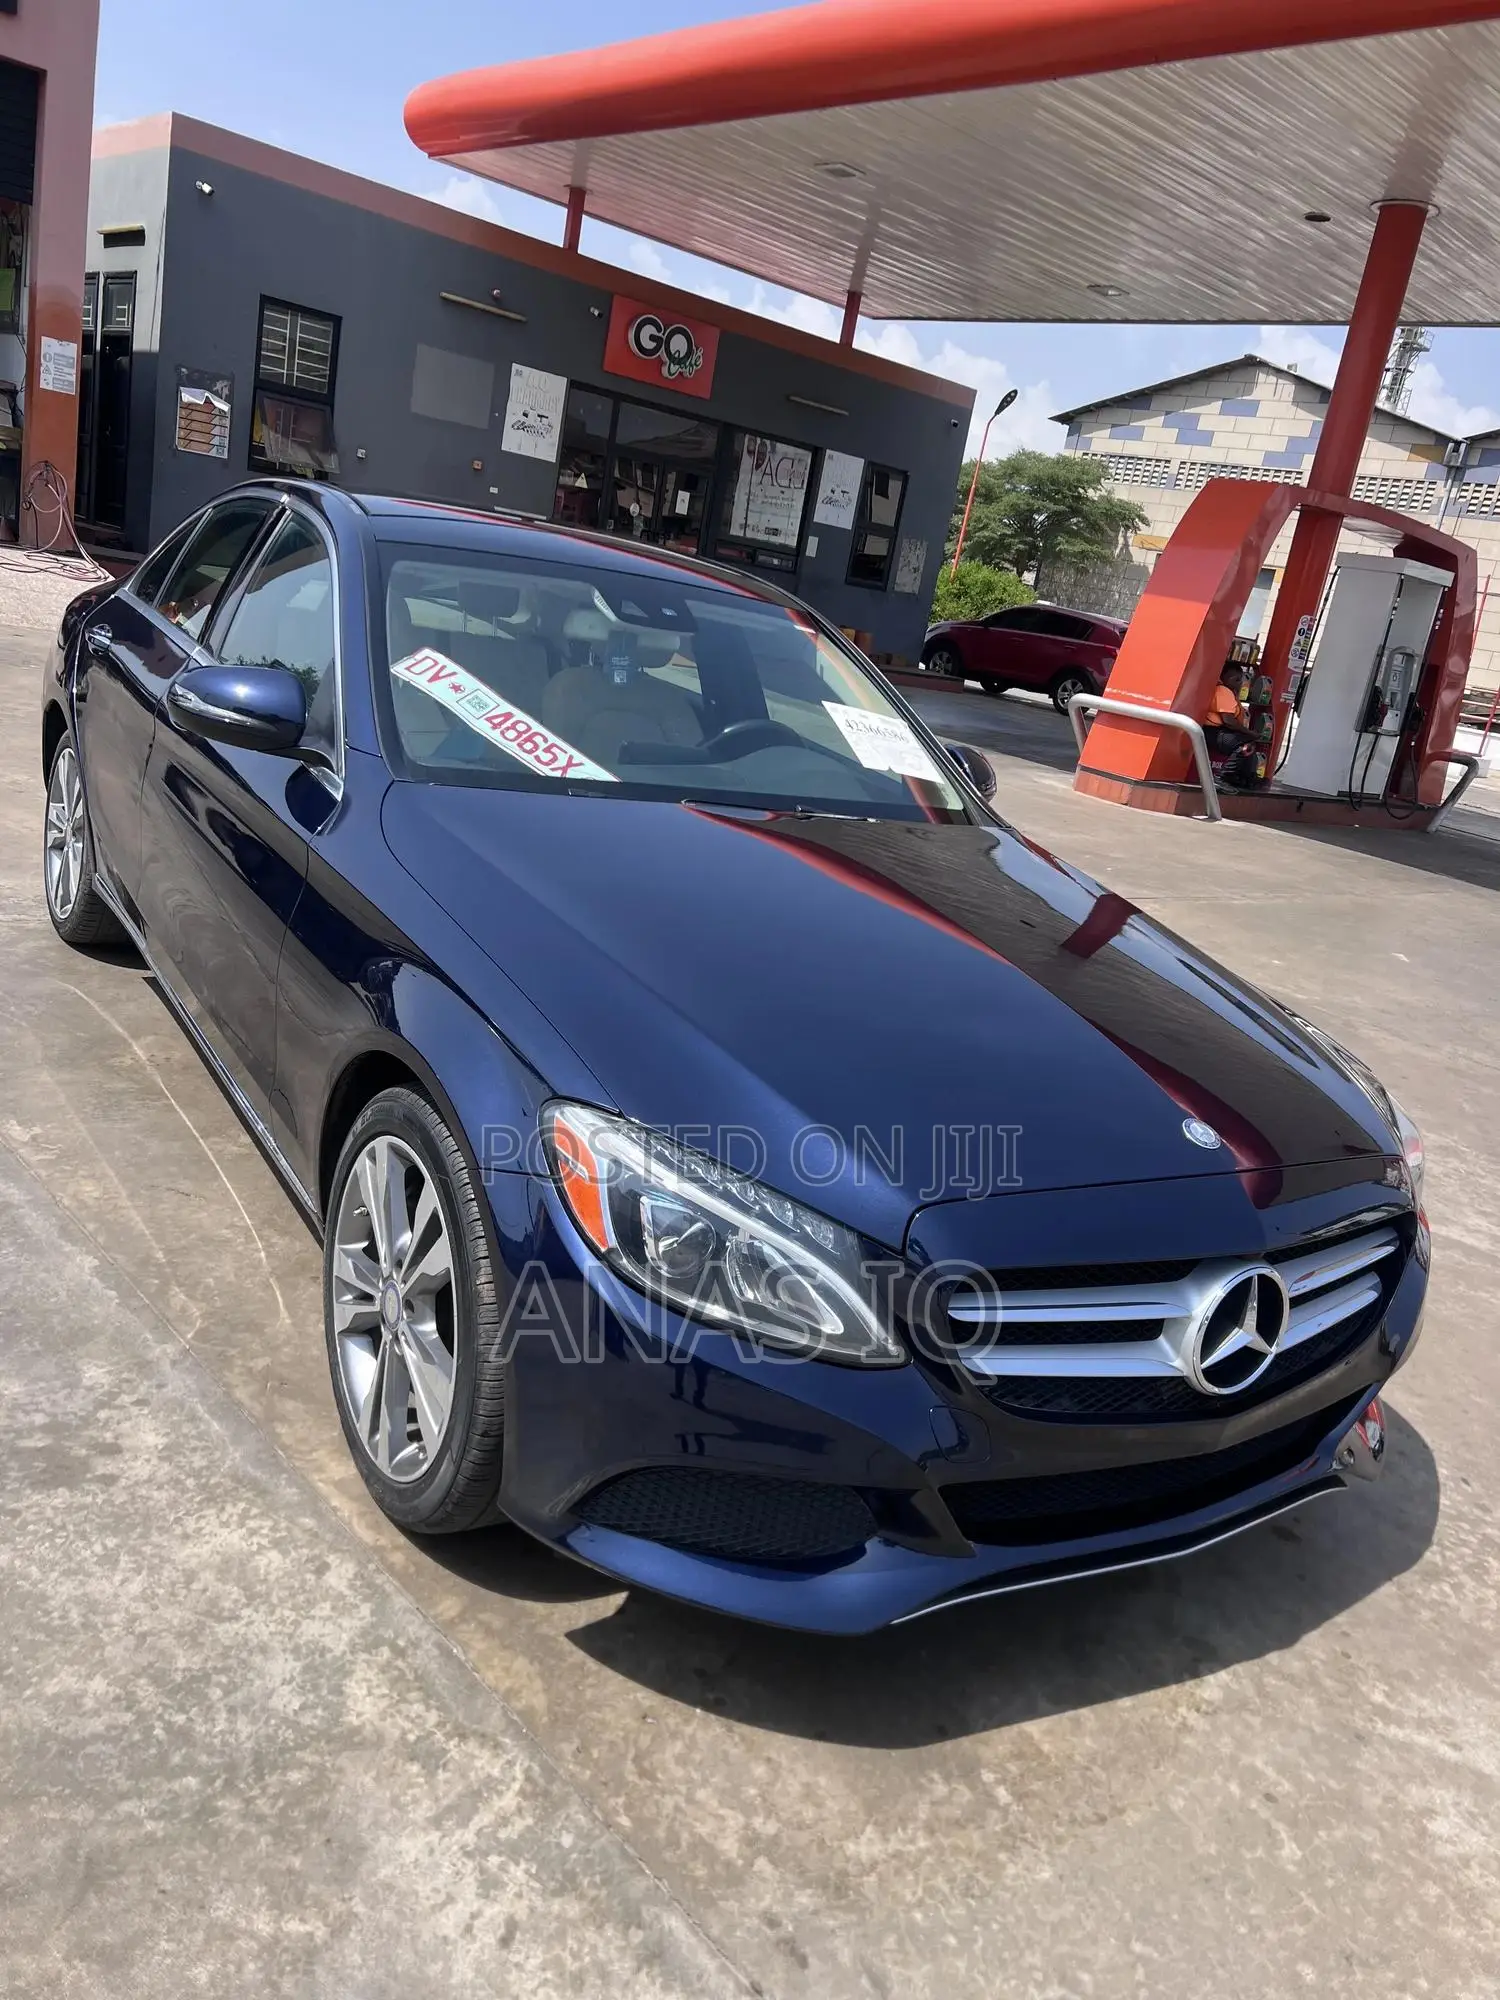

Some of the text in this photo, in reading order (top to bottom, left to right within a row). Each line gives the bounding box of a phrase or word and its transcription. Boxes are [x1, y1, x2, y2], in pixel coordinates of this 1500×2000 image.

[629, 314, 695, 361] GO
[404, 655, 584, 778] DV 4865X
